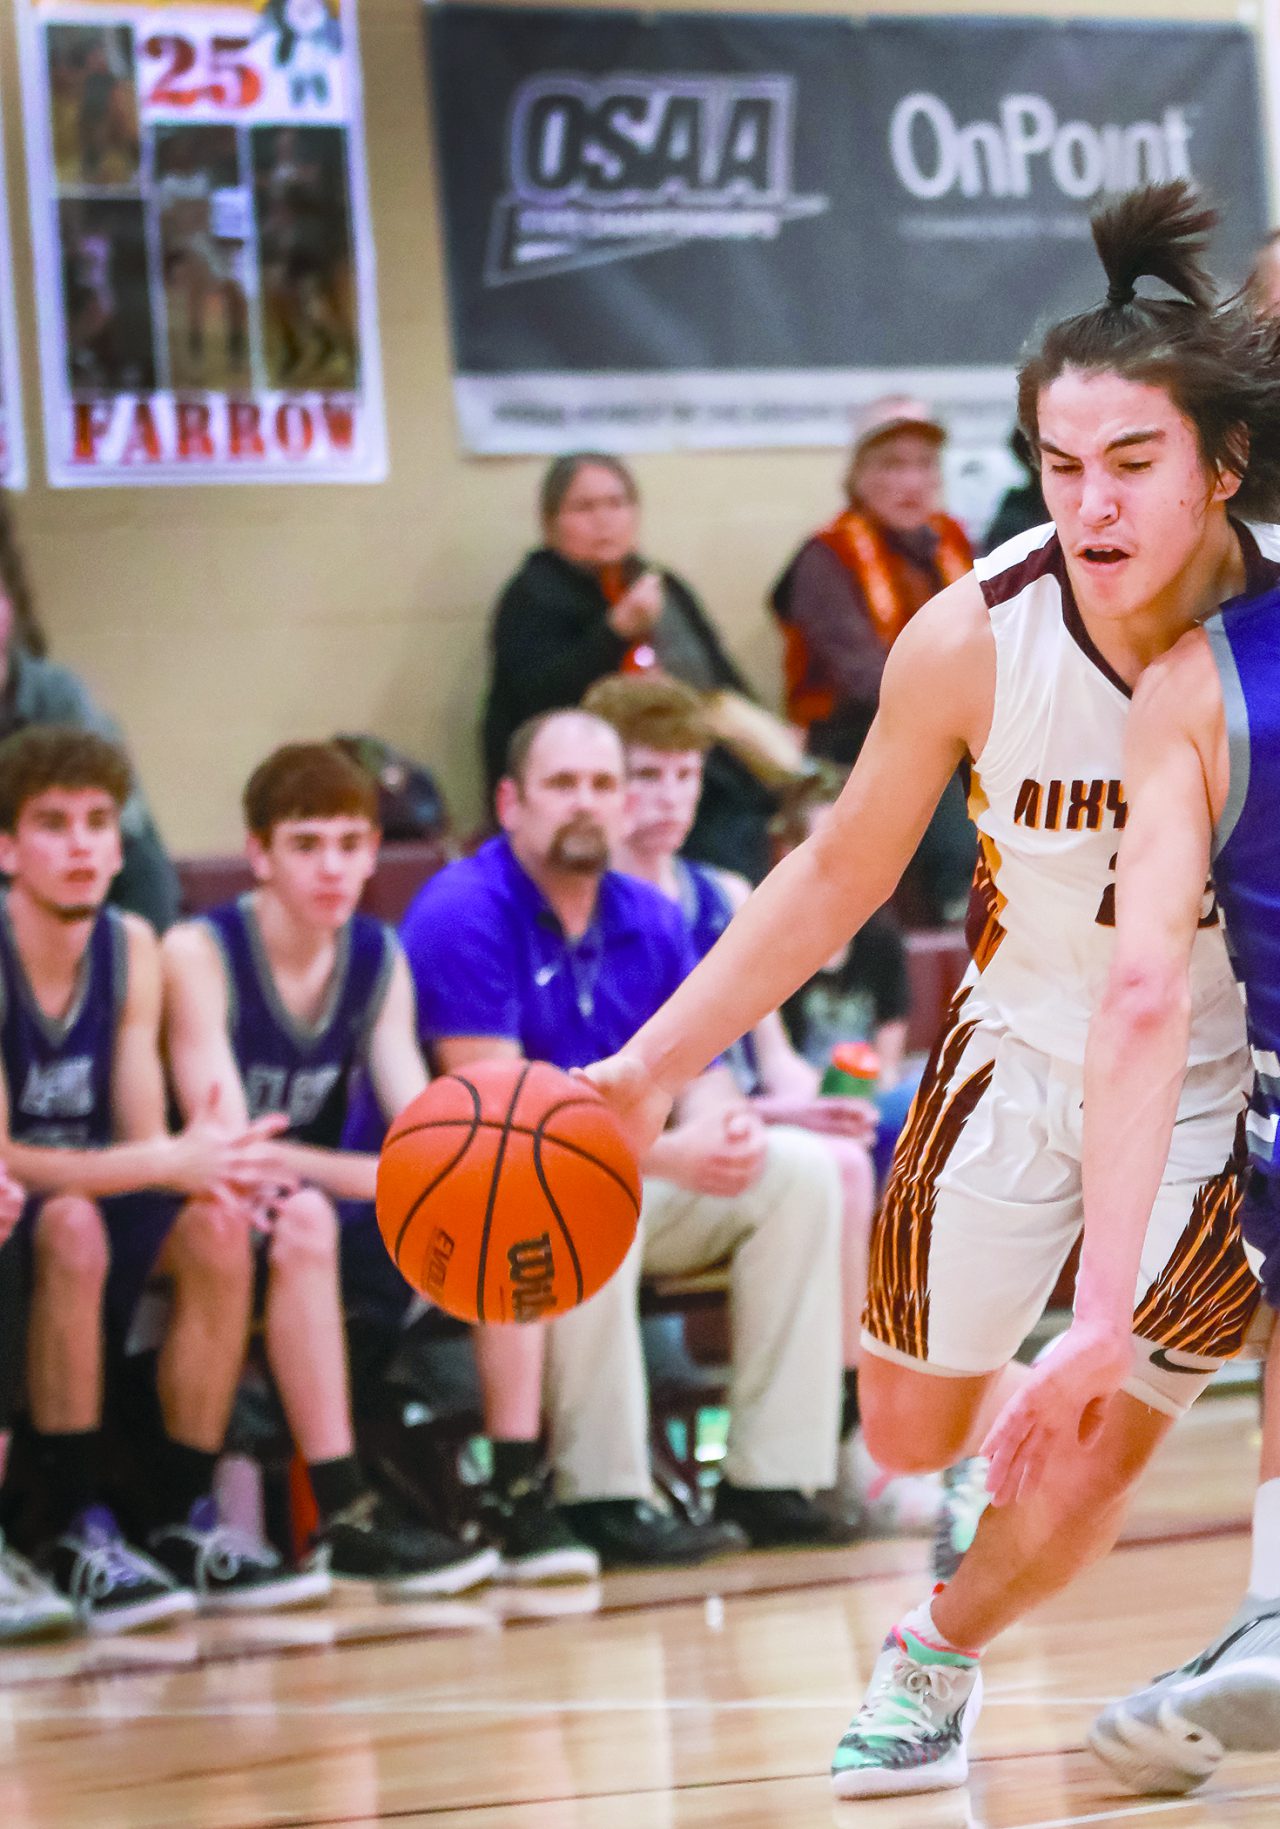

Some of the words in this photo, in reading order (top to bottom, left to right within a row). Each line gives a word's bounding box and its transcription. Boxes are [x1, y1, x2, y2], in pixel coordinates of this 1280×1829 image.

[143, 34, 262, 108] 25
[527, 94, 775, 191] OSAA
[890, 92, 1194, 198] OnPoint
[70, 402, 358, 463] FARROW
[1013, 778, 1129, 832] NIXY
